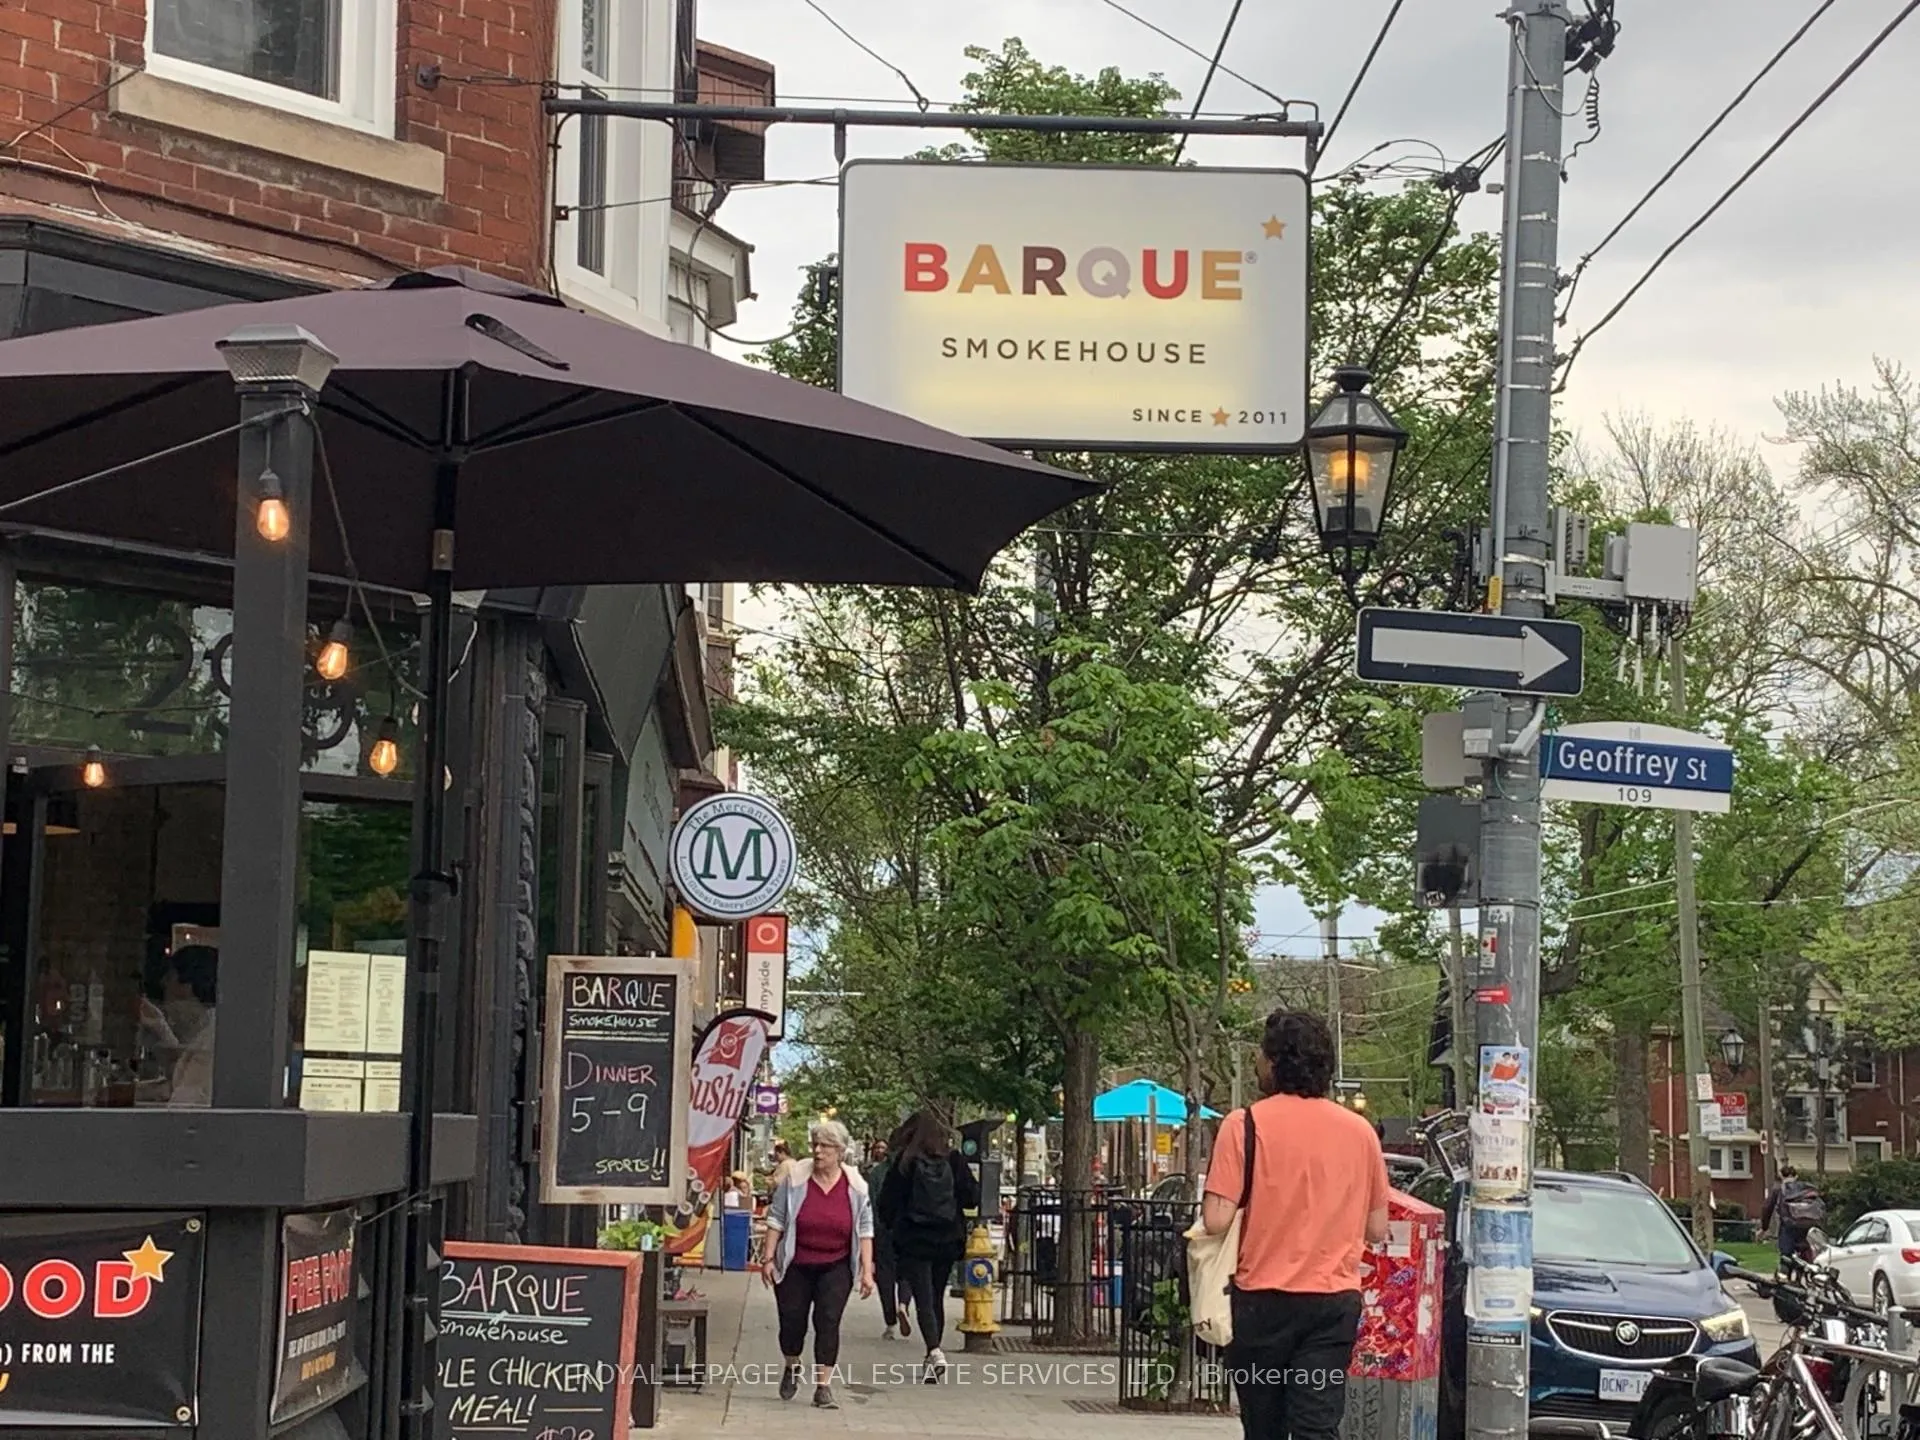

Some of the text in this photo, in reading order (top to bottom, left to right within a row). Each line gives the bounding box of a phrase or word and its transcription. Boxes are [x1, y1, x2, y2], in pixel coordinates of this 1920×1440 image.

[904, 242, 1243, 300] BARQUE
[941, 337, 1207, 365] SMOKEHOUSE
[1132, 408, 1287, 424] SINCE 2011
[1559, 741, 1707, 784] Geoffrey St
[1617, 787, 1652, 802] 109
[687, 802, 779, 834] The Mercantile
[696, 826, 770, 881] M
[571, 976, 670, 1009] BARQUE
[564, 1051, 657, 1091] DINNER
[22, 1343, 72, 1364] FROM
[81, 1343, 115, 1364] THE
[438, 1356, 604, 1393] LE CHICKEN
[449, 1394, 536, 1424] MEAL!
